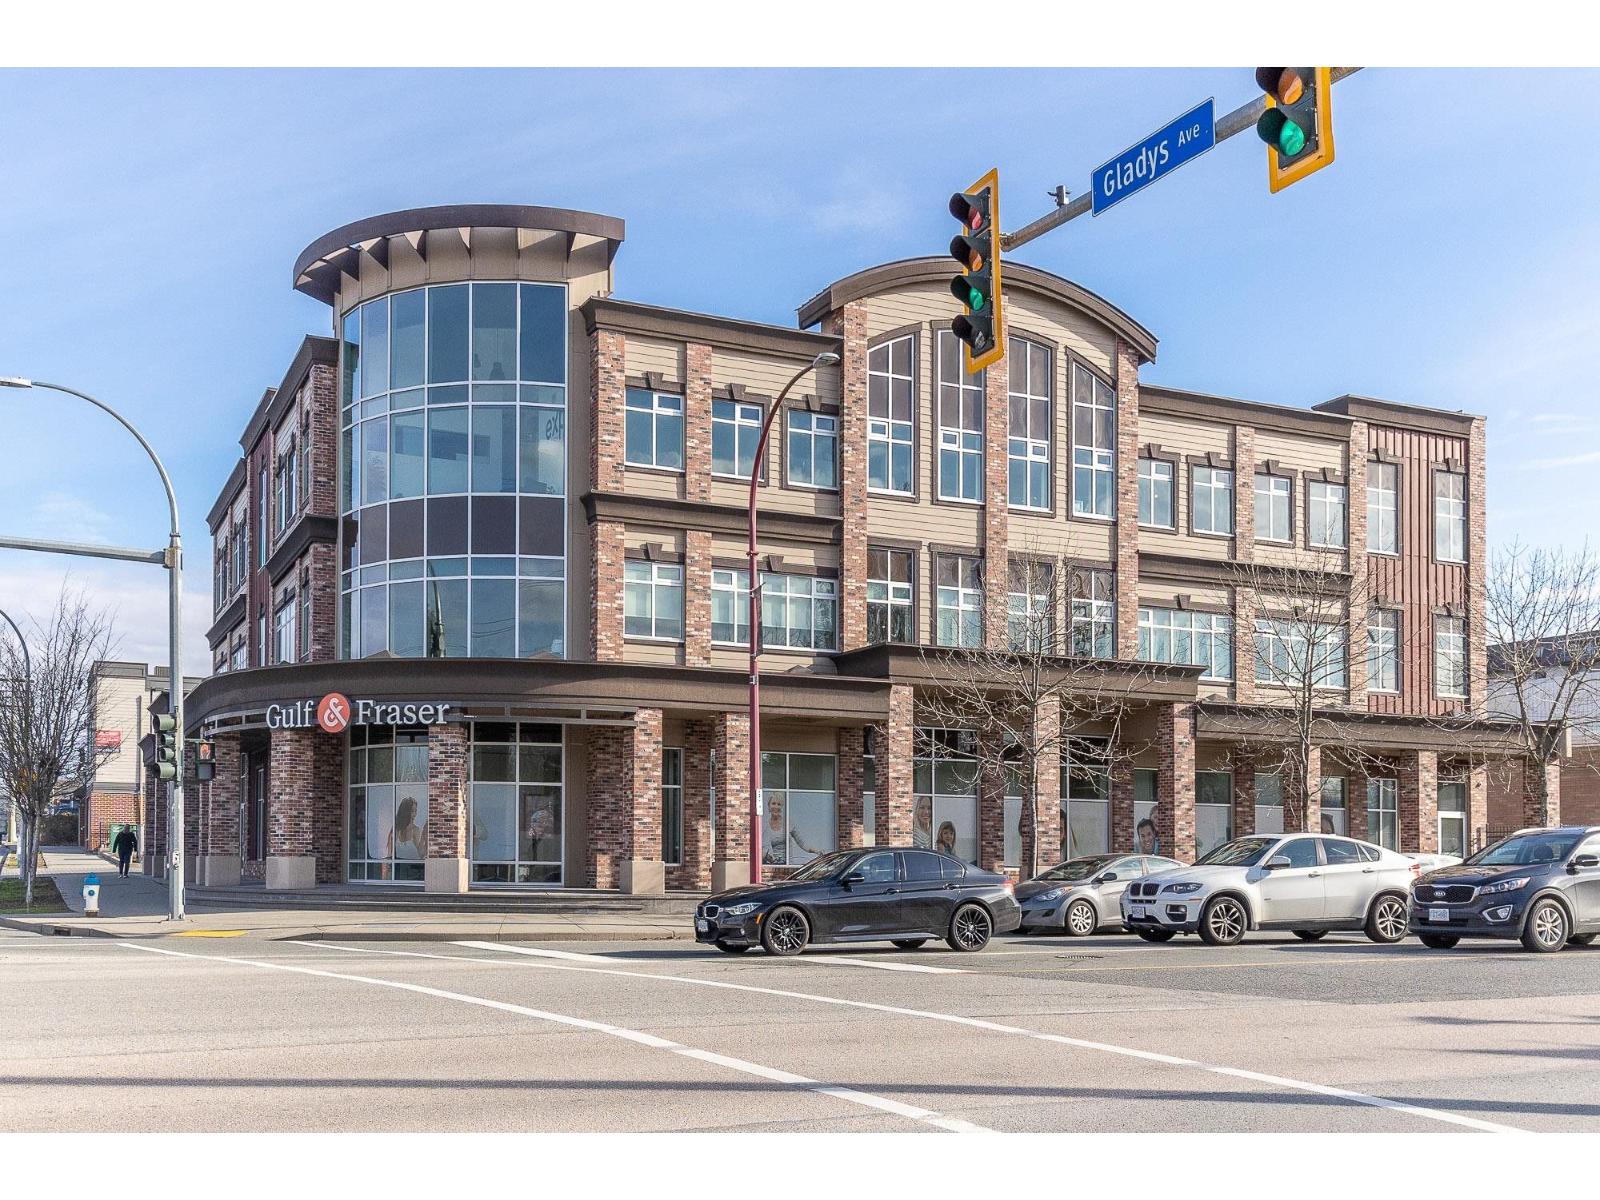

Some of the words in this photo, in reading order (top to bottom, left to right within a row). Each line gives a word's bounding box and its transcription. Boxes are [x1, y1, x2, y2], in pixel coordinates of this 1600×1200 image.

[1103, 140, 1169, 197] Gladys
[1178, 123, 1200, 148] Ave
[265, 700, 314, 729] Gulf
[323, 697, 349, 728] &
[355, 700, 450, 726] Fraser
